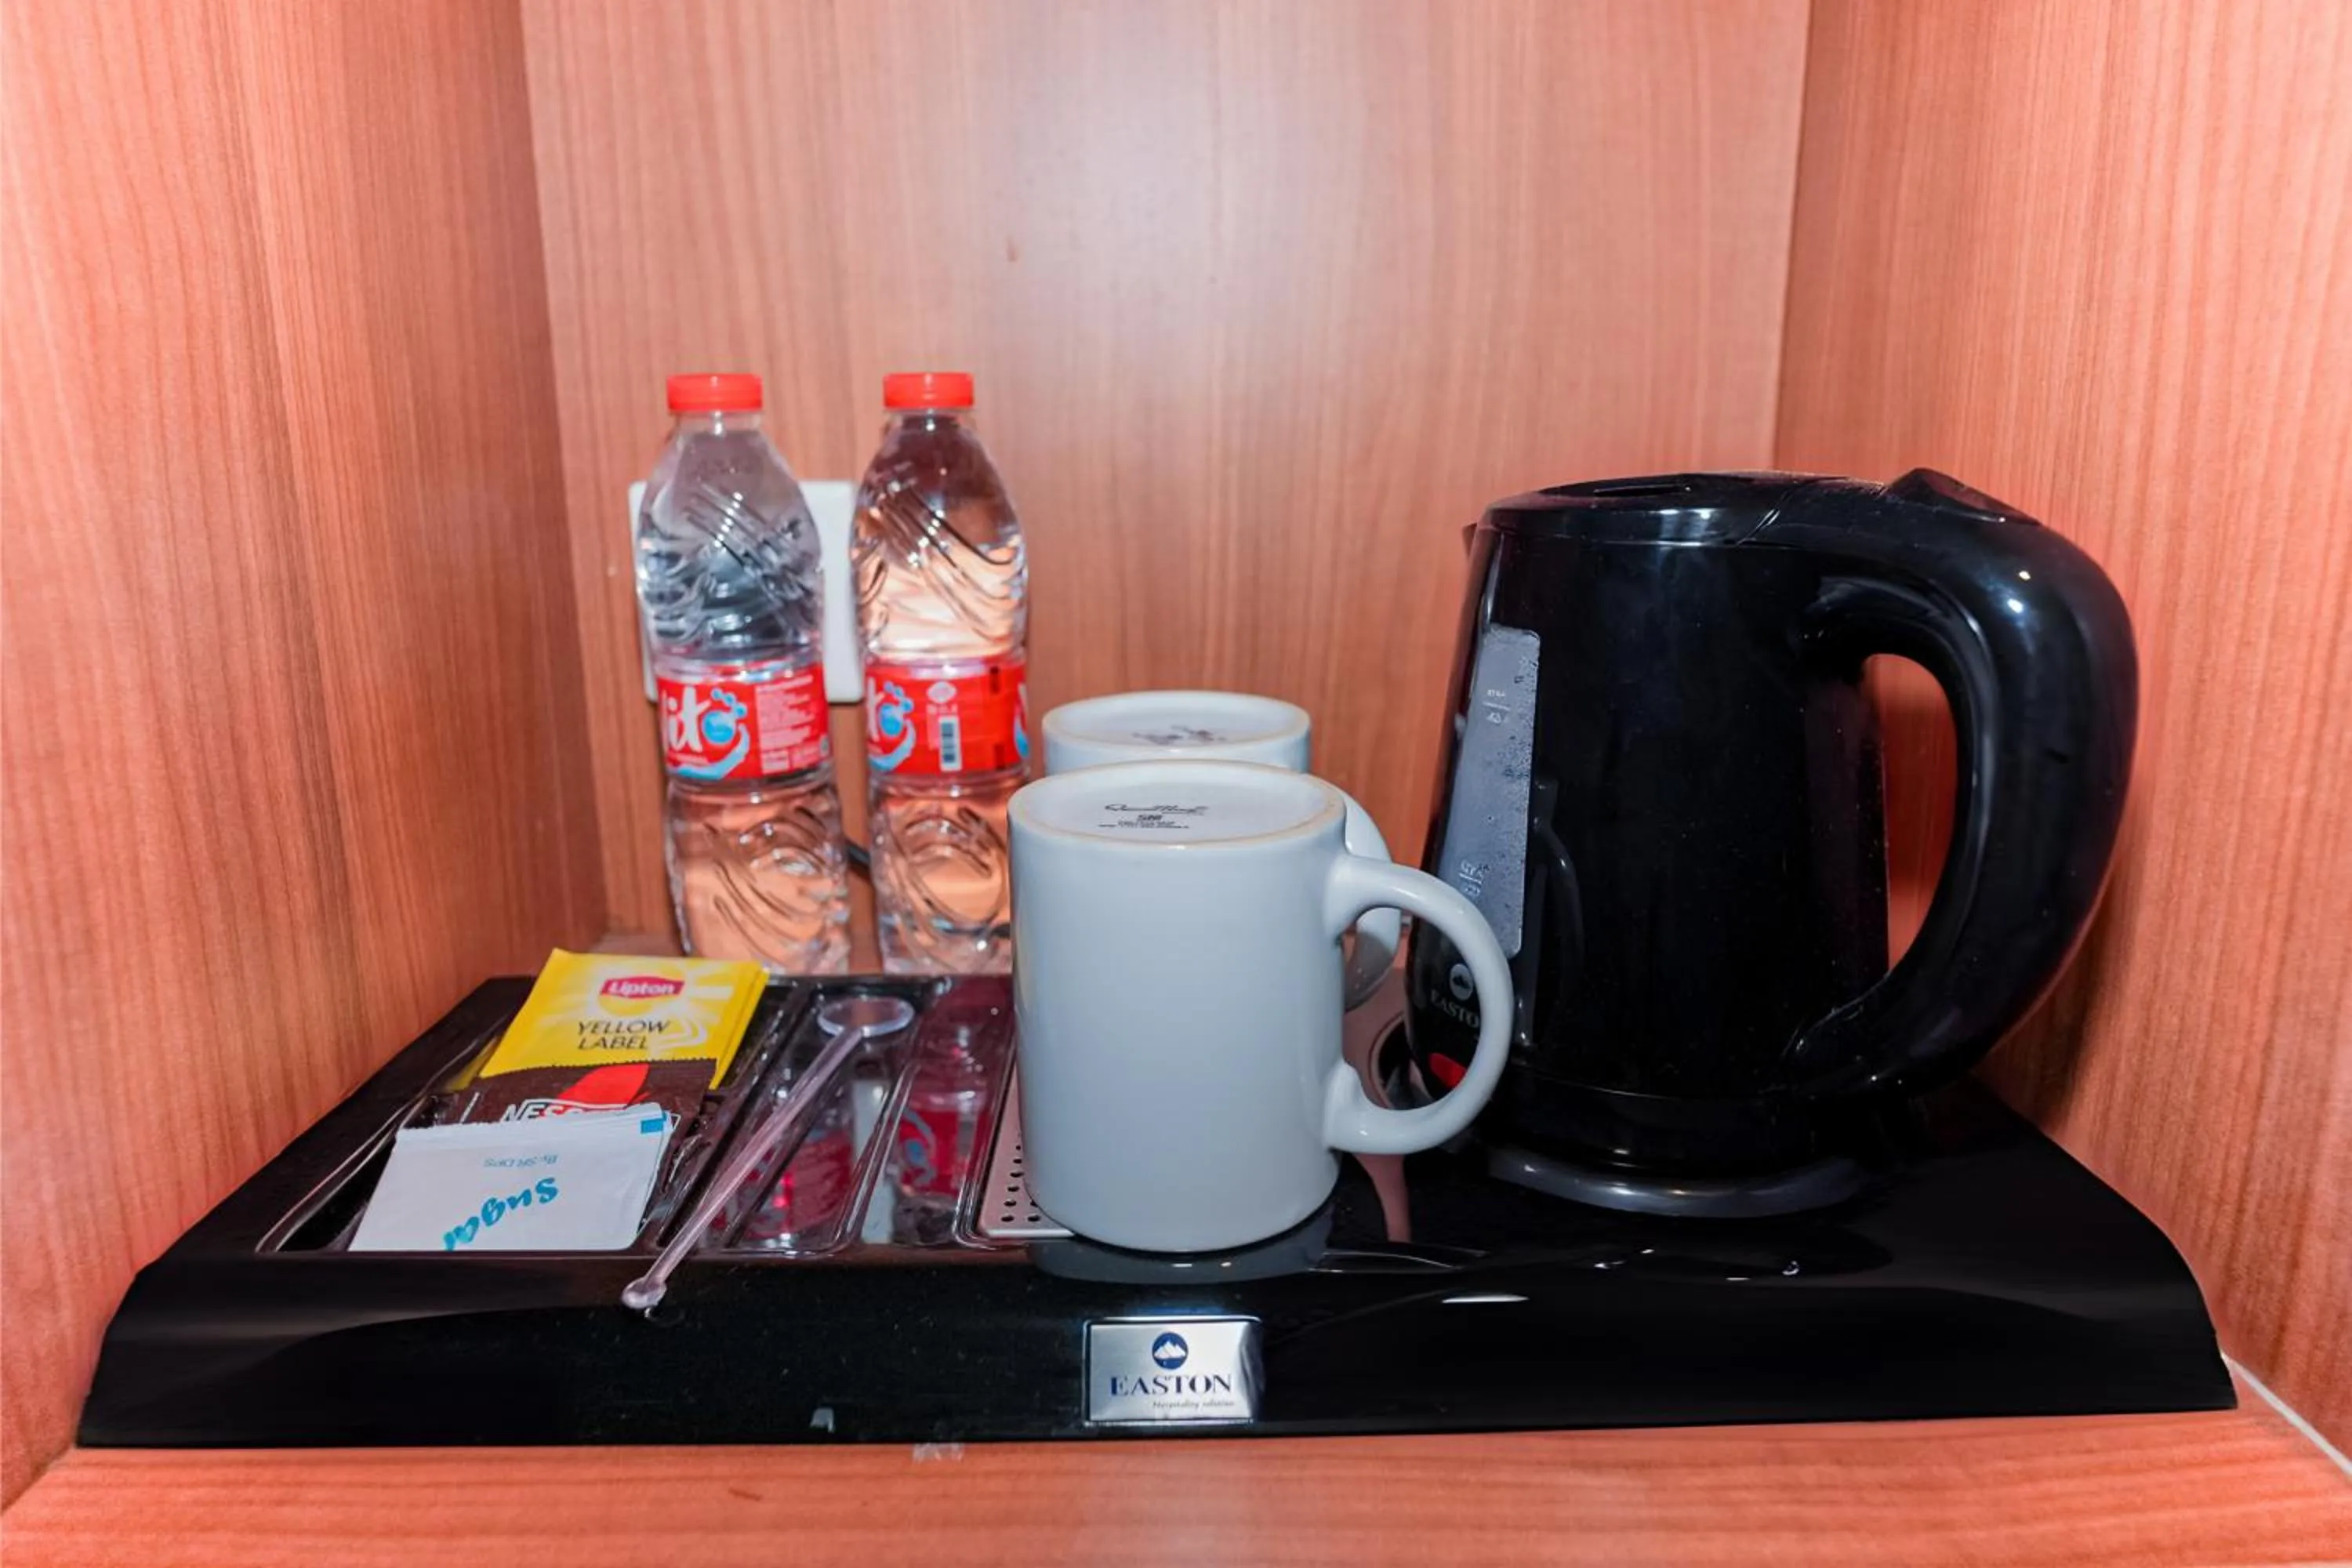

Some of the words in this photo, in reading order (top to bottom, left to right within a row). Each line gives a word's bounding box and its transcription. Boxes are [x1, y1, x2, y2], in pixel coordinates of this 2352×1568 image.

[608, 980, 675, 997] Lipton
[1430, 988, 1480, 1028] EASTO
[579, 1021, 669, 1035] YELLOW
[577, 1036, 648, 1051] LABEL
[1110, 1374, 1231, 1396] EASTON
